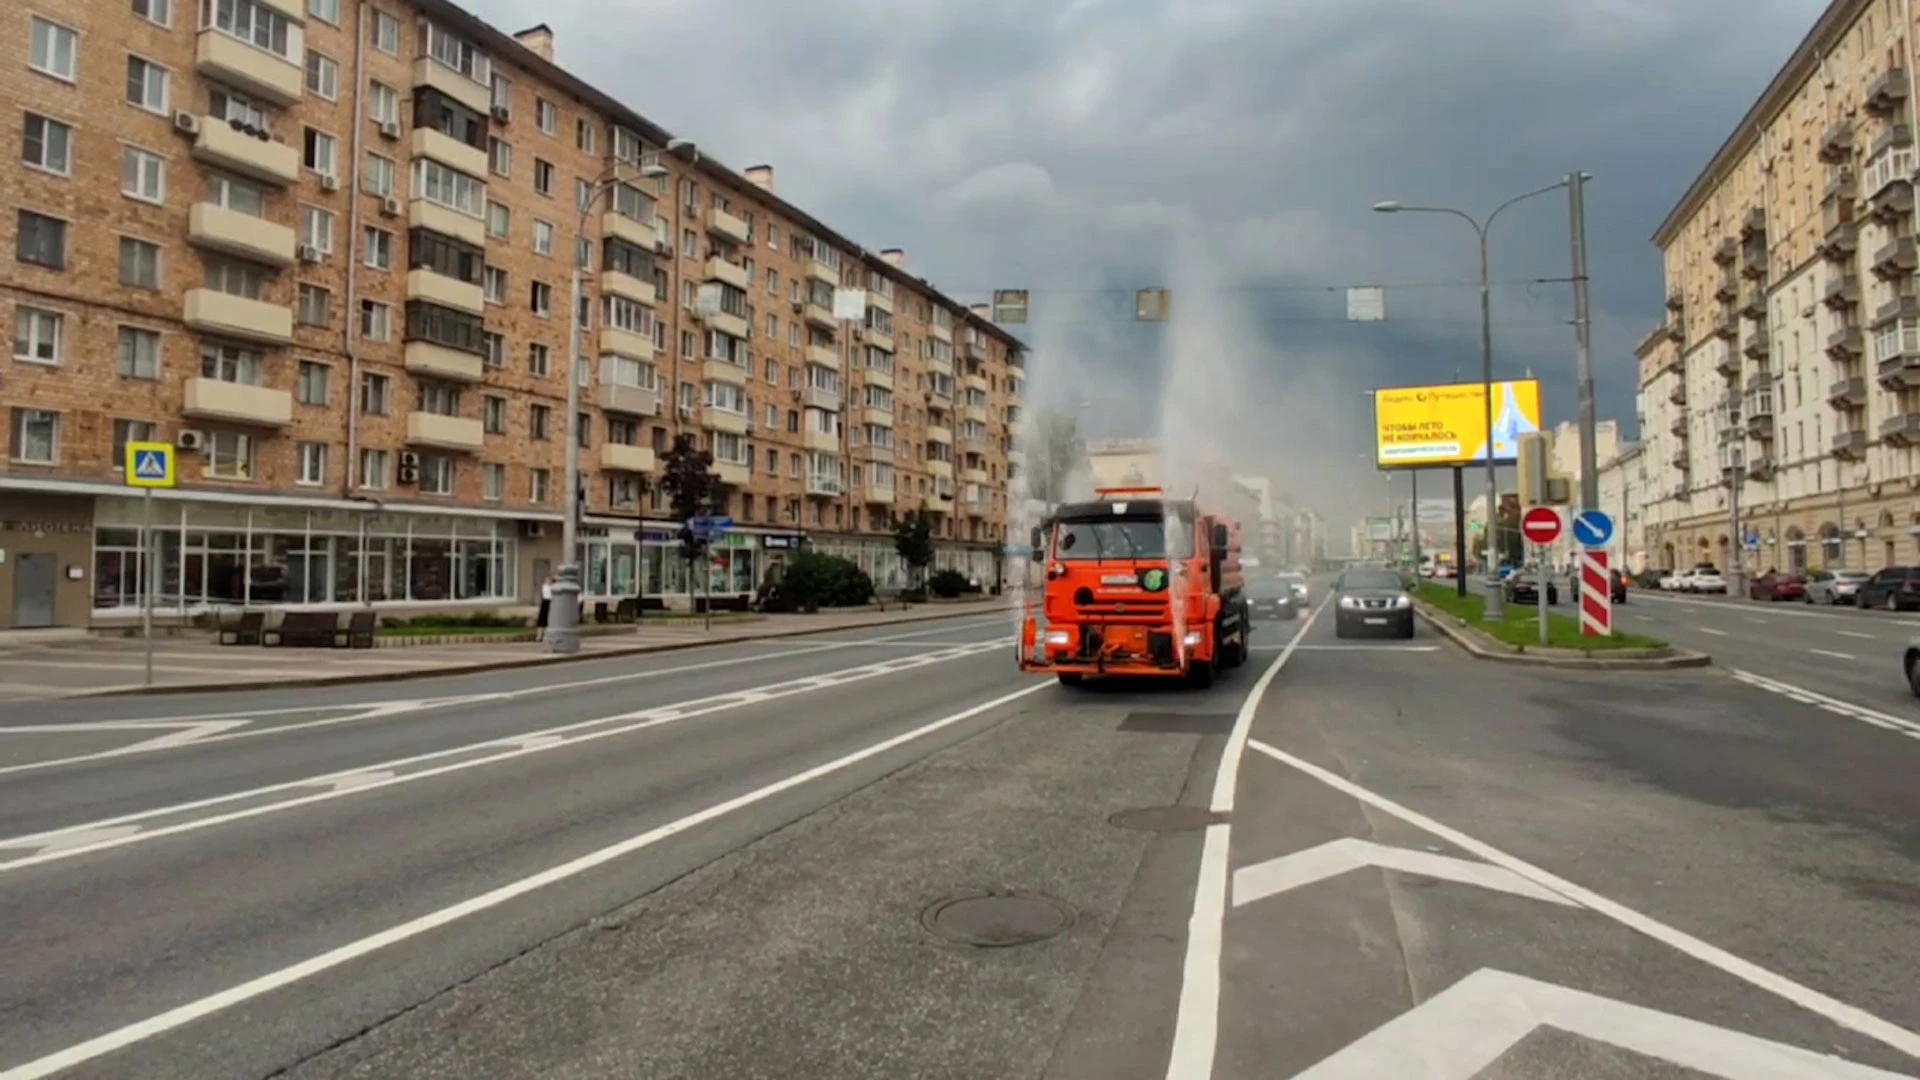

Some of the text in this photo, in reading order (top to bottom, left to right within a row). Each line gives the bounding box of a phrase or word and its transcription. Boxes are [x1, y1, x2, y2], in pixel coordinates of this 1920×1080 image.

[1383, 421, 1444, 433] ЧТОБЫ ЛЕТО
[1383, 431, 1457, 443] НЕ КОНЧАЛОСЬ
